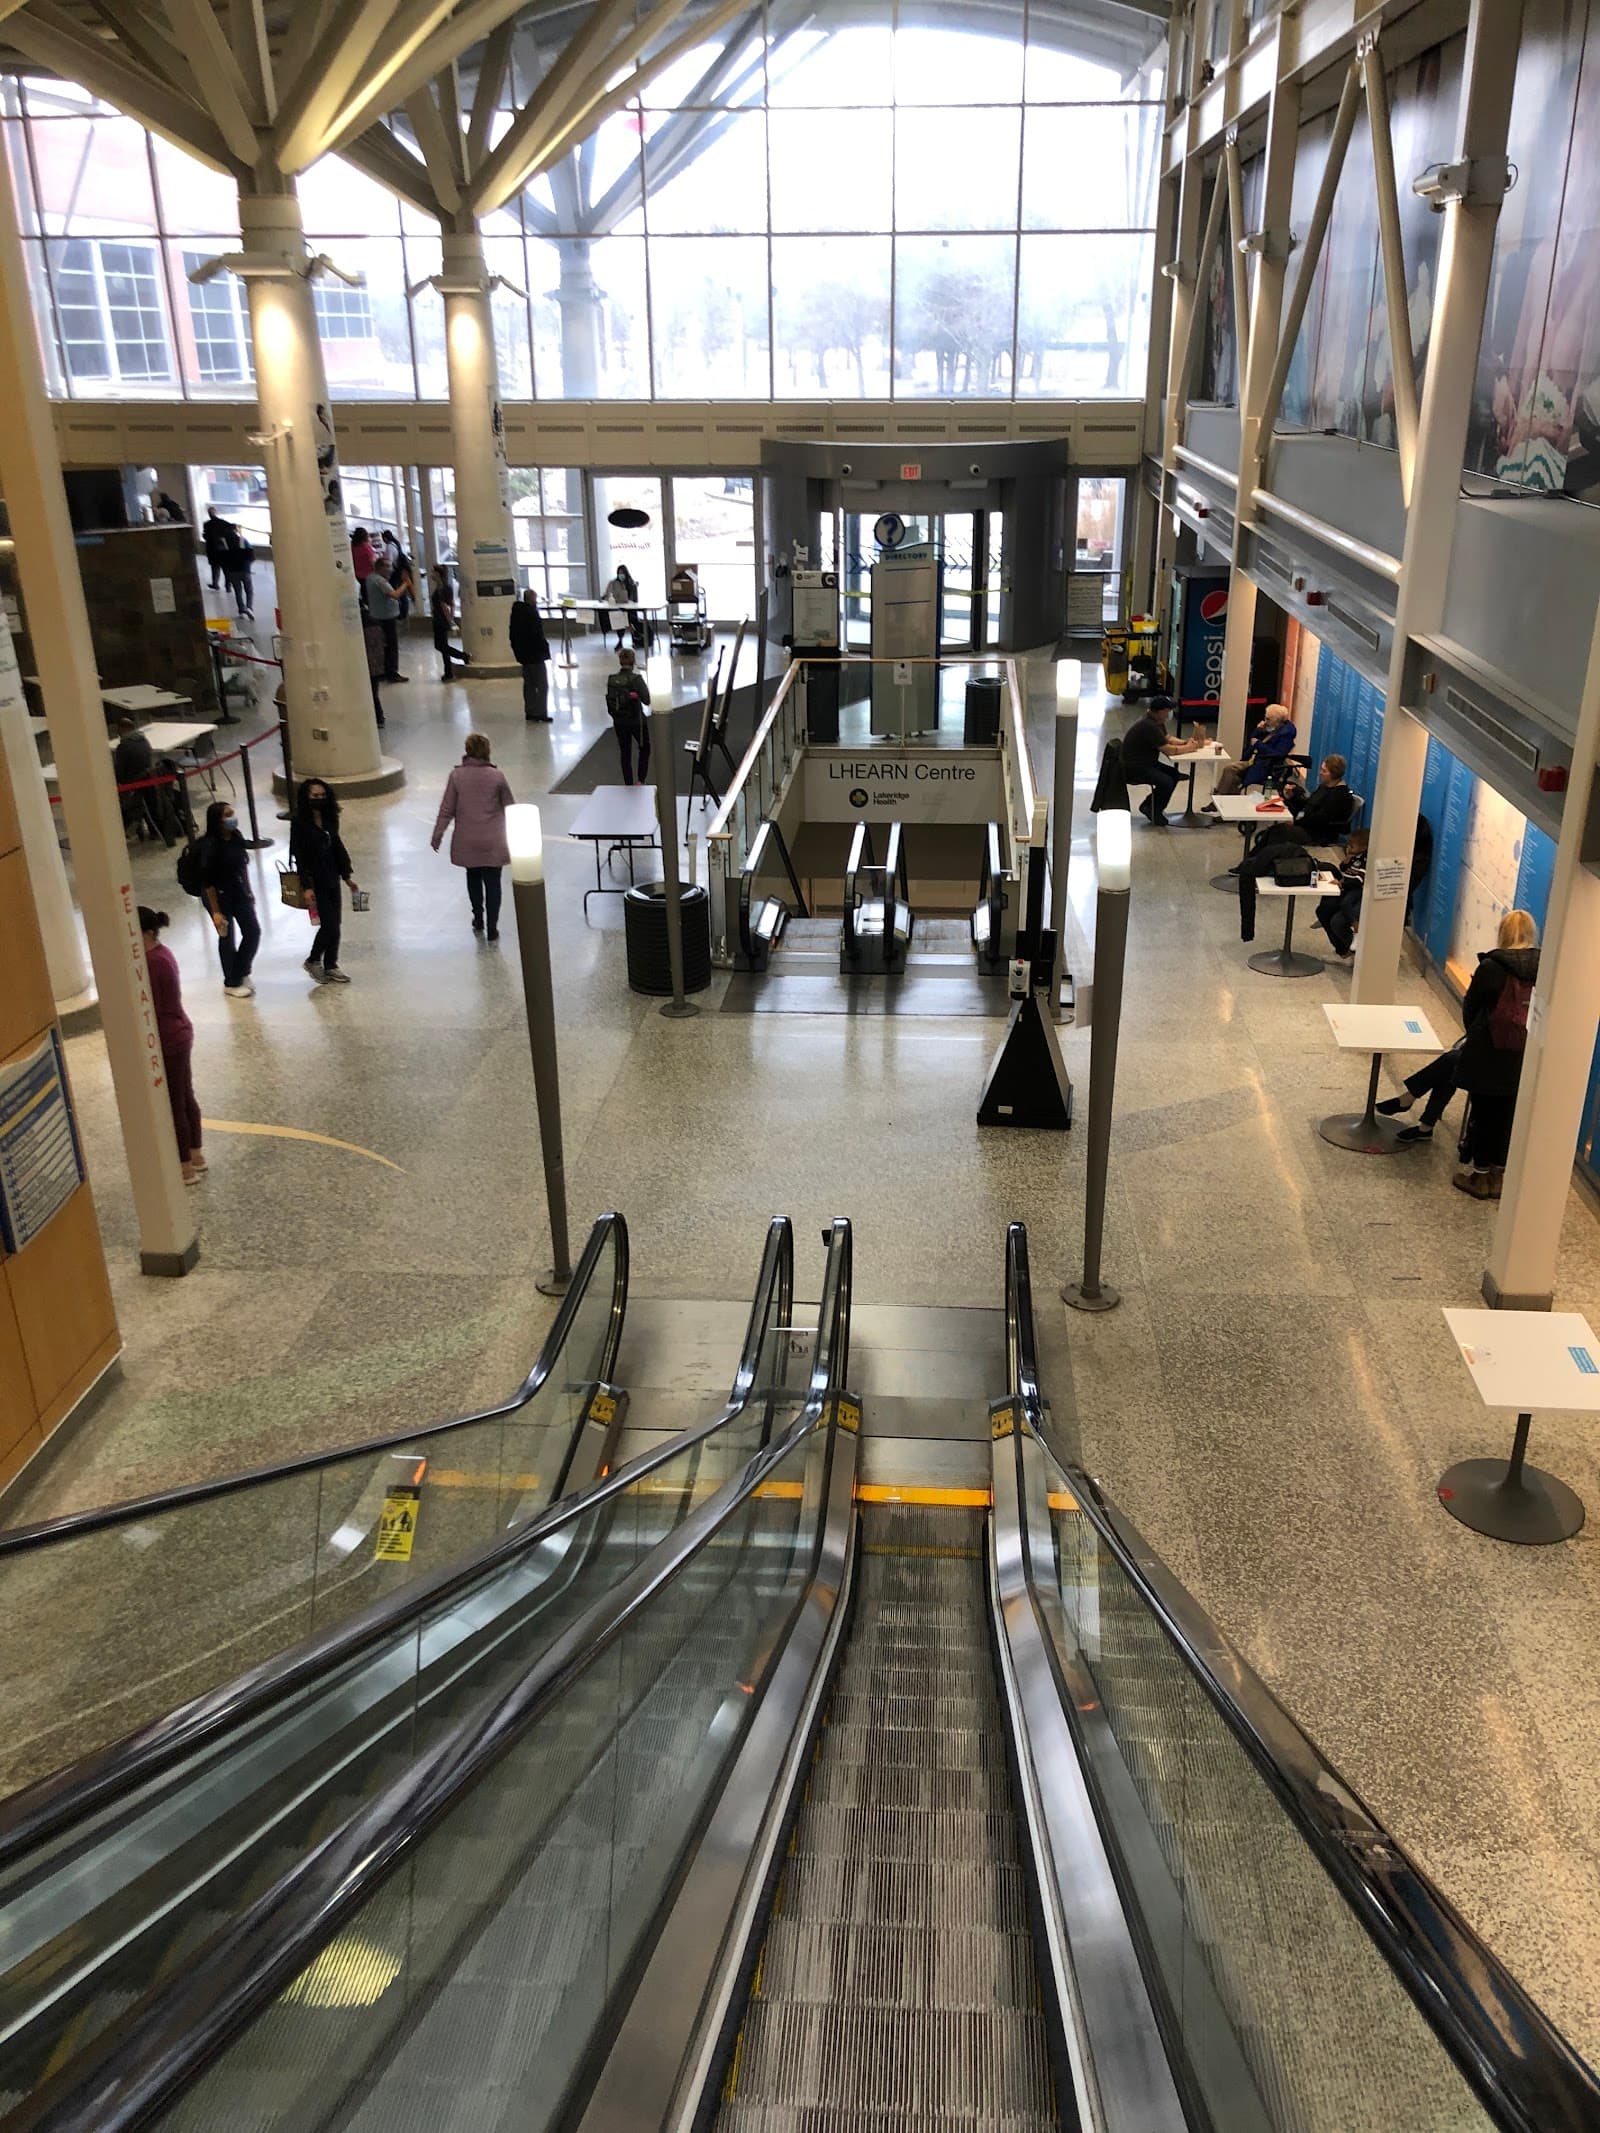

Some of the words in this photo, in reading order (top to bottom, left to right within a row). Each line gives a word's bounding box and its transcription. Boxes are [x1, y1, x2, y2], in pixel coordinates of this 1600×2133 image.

[903, 466, 919, 479] EXIT
[885, 552, 928, 561] DIRECTORY
[829, 763, 908, 780] LHEARN
[915, 764, 976, 781] Centre
[873, 791, 910, 800] Lakeridge
[873, 798, 897, 806] Health
[123, 899, 160, 1070] ELEVATOR
